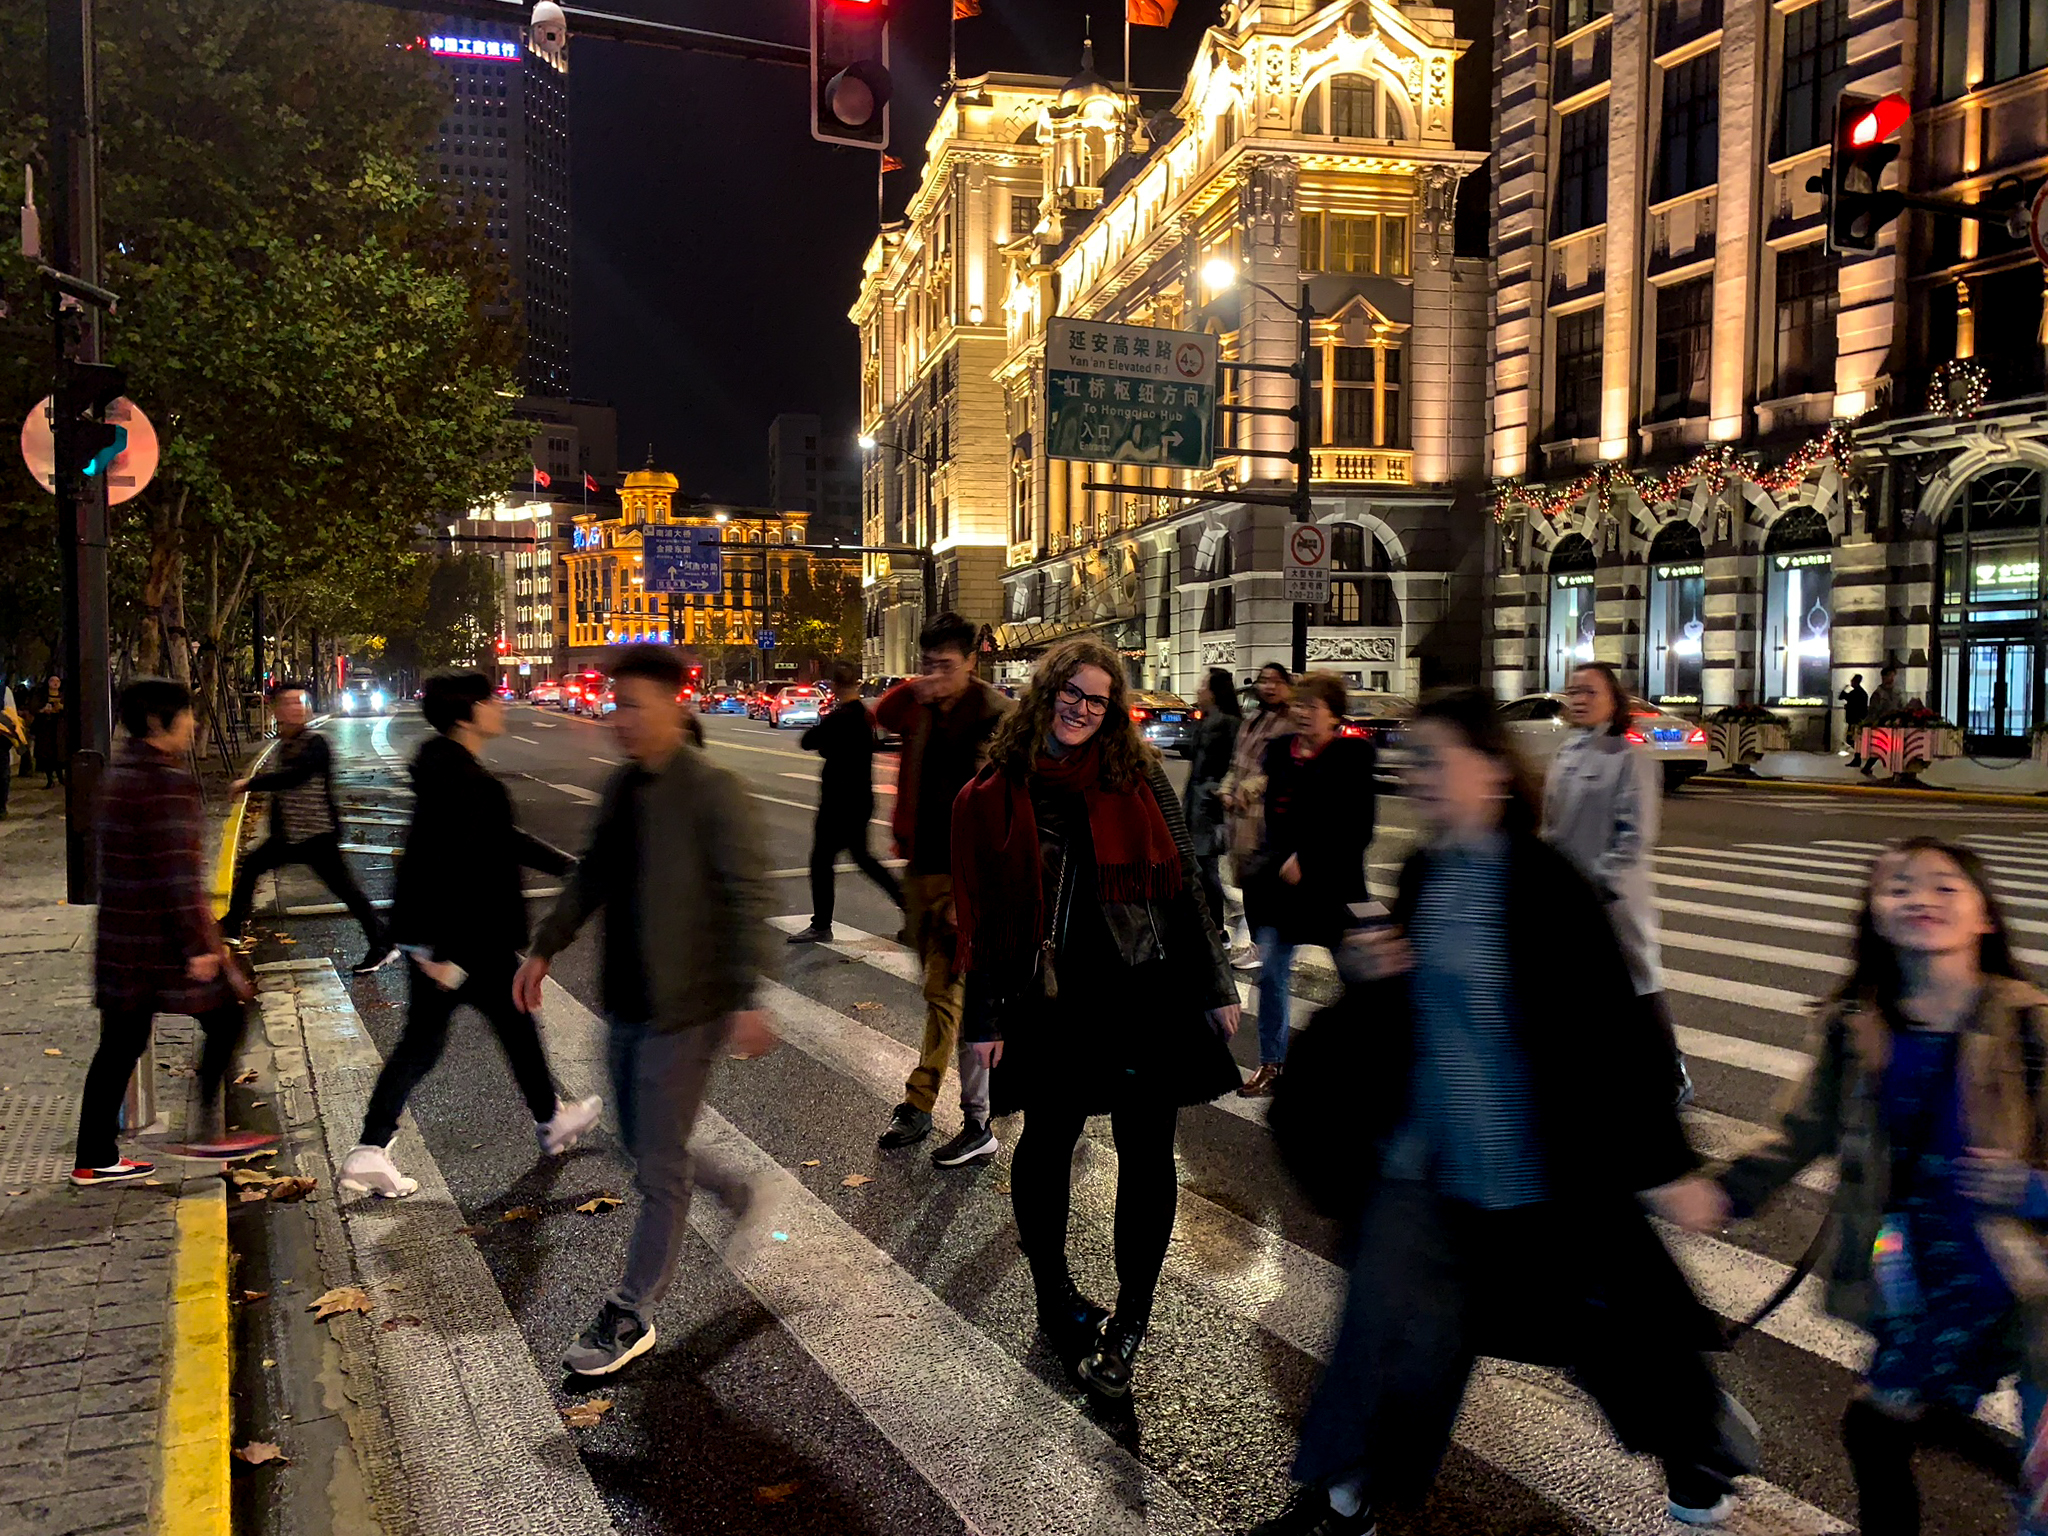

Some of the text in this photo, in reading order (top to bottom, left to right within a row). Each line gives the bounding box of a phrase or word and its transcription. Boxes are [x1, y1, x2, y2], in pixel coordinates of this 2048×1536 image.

[1069, 329, 1172, 361] 延安高架路
[1069, 354, 1169, 376] Yan'an Elevated Rd
[1063, 375, 1199, 408] 虹桥枢纽方向
[1083, 402, 1183, 422] To Hongqiao Hub
[1080, 421, 1111, 440] 入口
